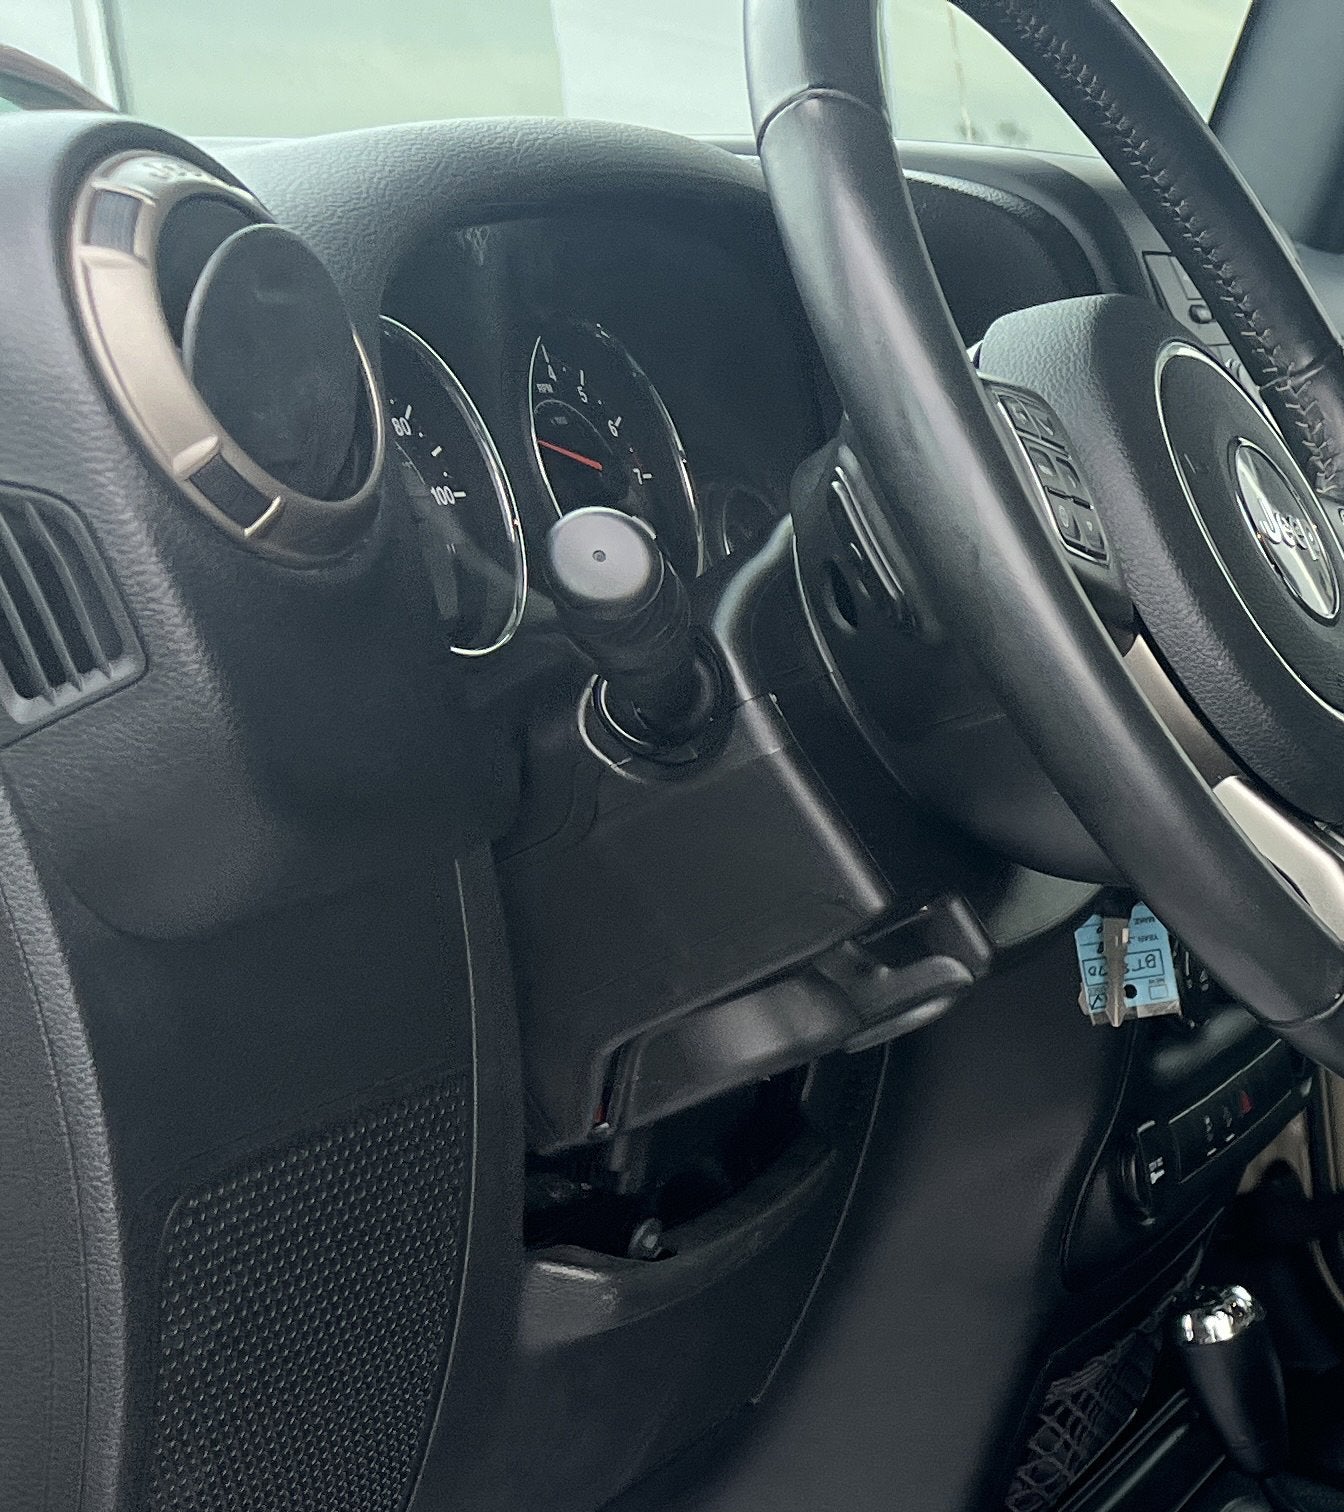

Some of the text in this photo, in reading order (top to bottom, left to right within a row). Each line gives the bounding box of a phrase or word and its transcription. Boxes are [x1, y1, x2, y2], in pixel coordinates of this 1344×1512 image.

[392, 417, 412, 437] 80
[430, 485, 456, 506] 100
[1259, 498, 1321, 561] Jeep
